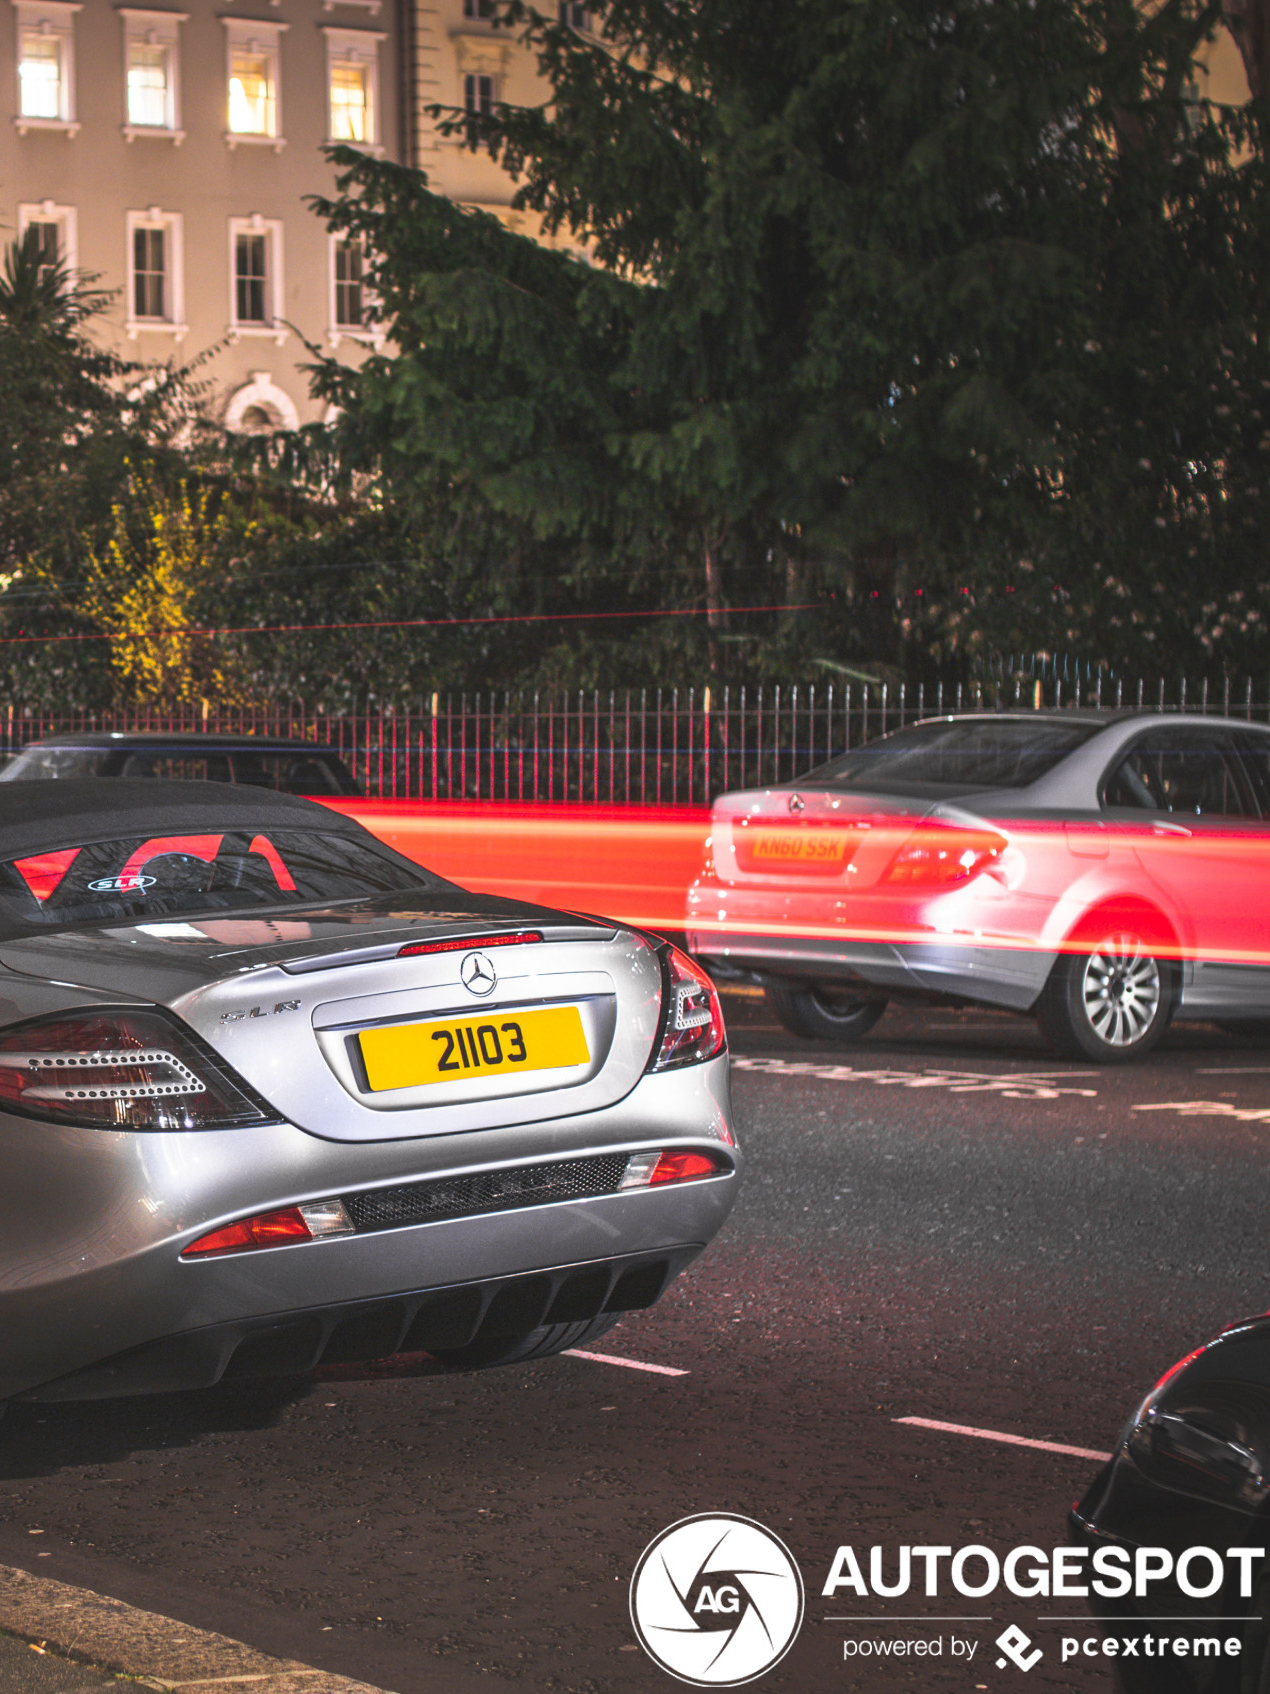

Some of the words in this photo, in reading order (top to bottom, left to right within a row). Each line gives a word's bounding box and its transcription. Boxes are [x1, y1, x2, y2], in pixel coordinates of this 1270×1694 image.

[758, 834, 803, 856] KN60
[805, 836, 841, 858] SSK
[97, 877, 145, 889] SLR
[219, 999, 302, 1025] SLR
[431, 1022, 527, 1071] 21103
